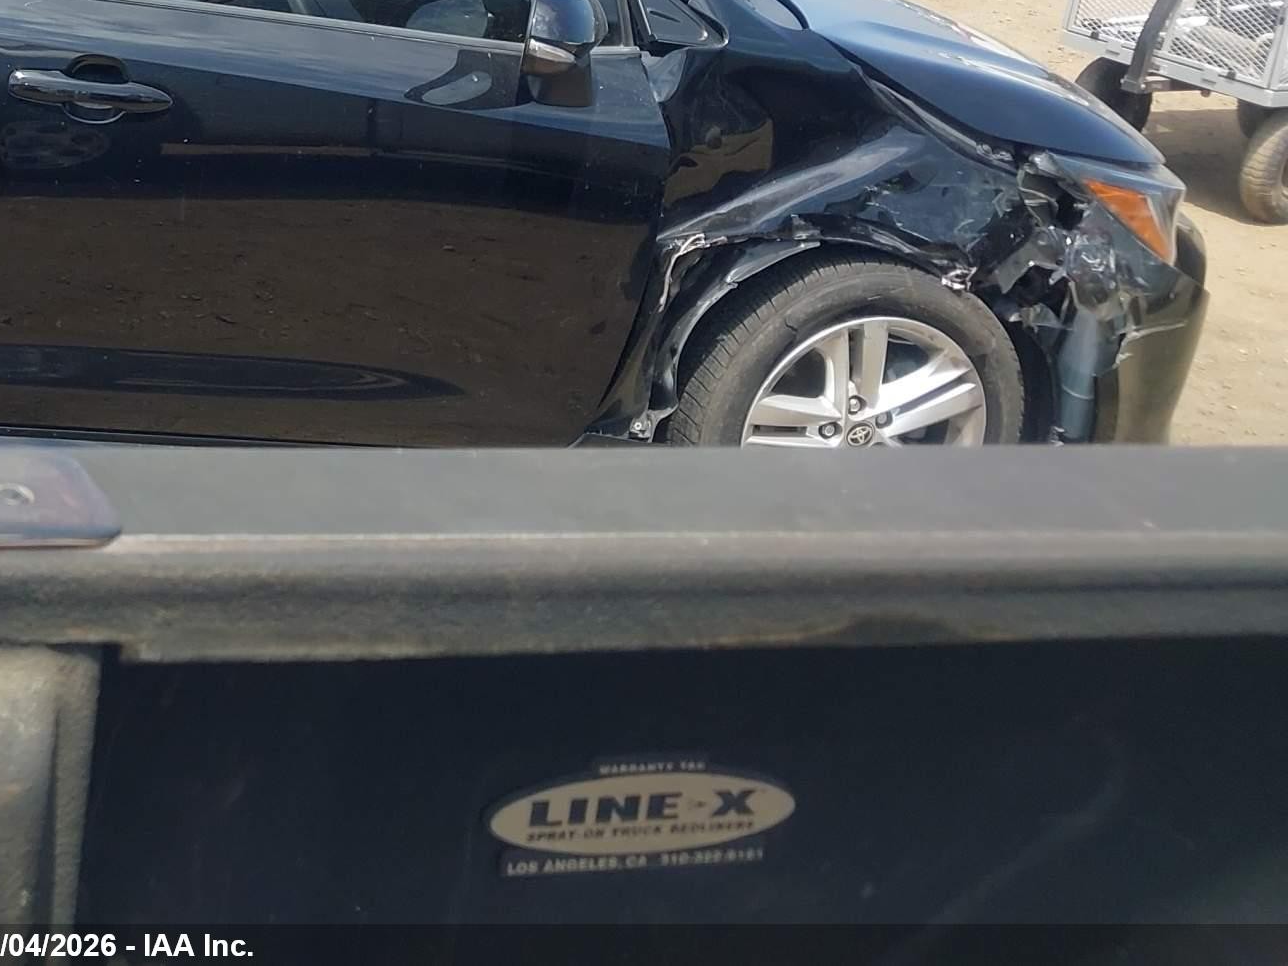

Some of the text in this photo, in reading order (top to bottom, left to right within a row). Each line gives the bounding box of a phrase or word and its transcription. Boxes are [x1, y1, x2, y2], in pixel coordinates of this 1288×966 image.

[528, 788, 757, 828] LINE-X
[611, 824, 664, 839] TRUCK
[506, 860, 538, 876] LOS
[625, 855, 647, 869] CA
